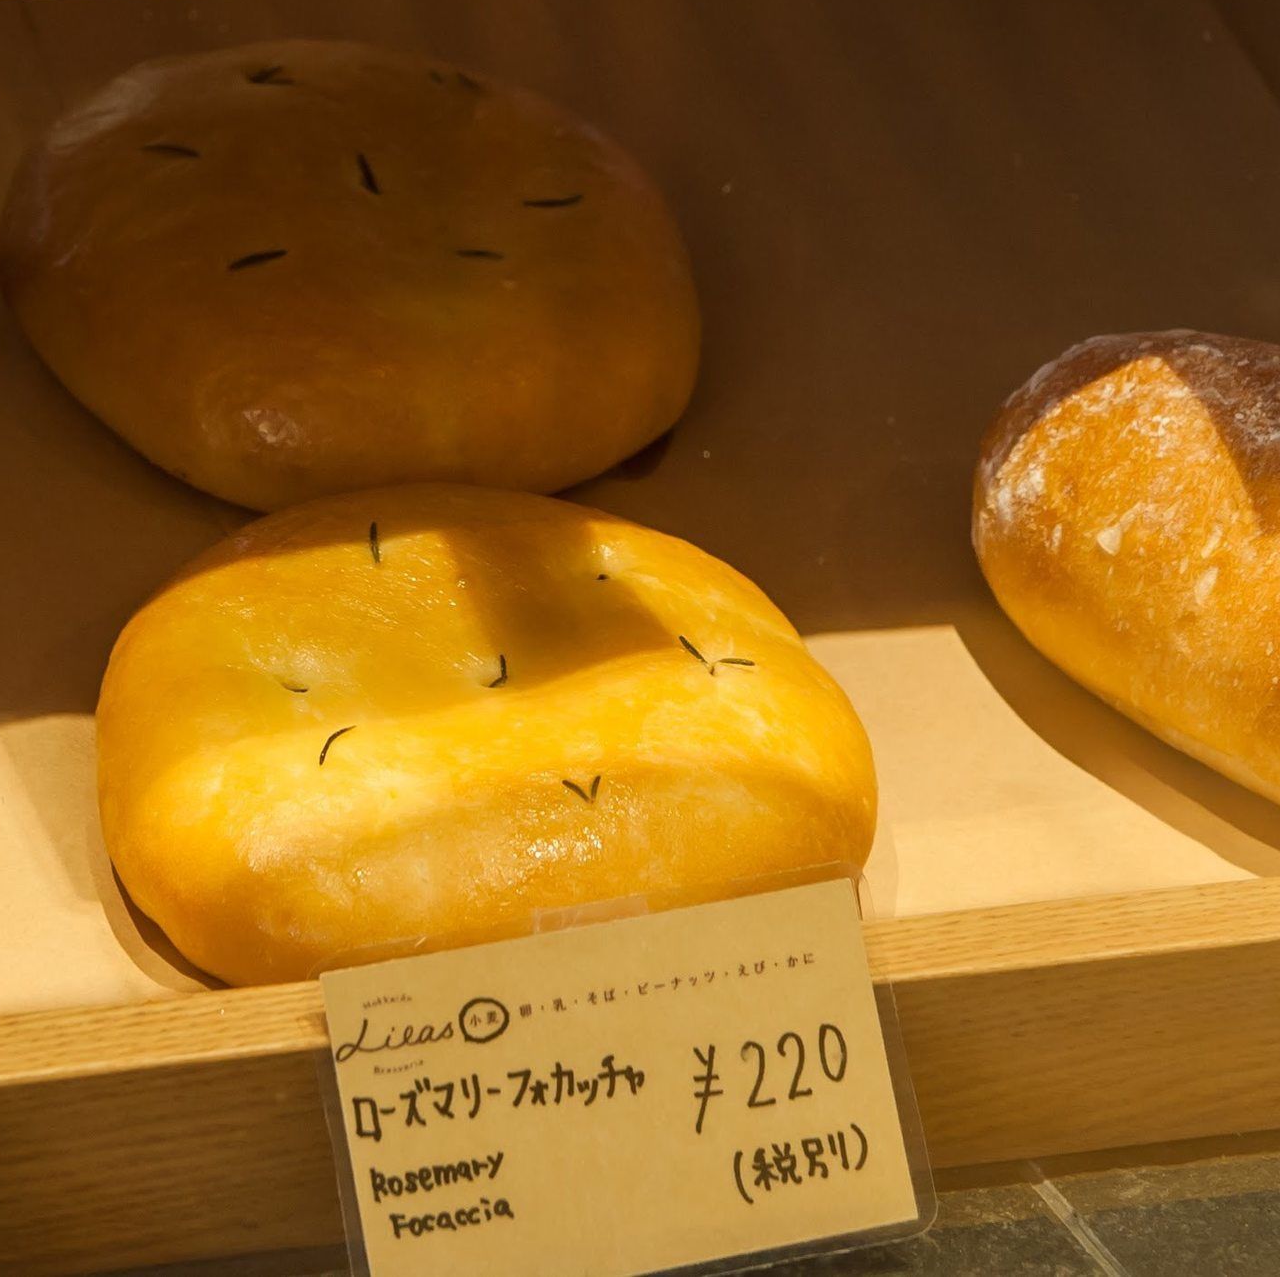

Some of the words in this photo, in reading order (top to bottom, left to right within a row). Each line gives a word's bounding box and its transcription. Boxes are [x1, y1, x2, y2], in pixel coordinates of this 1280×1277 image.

[693, 1023, 849, 1135] ¥220
[370, 1151, 505, 1203] Rosemary
[388, 1197, 515, 1239] Focaccia
